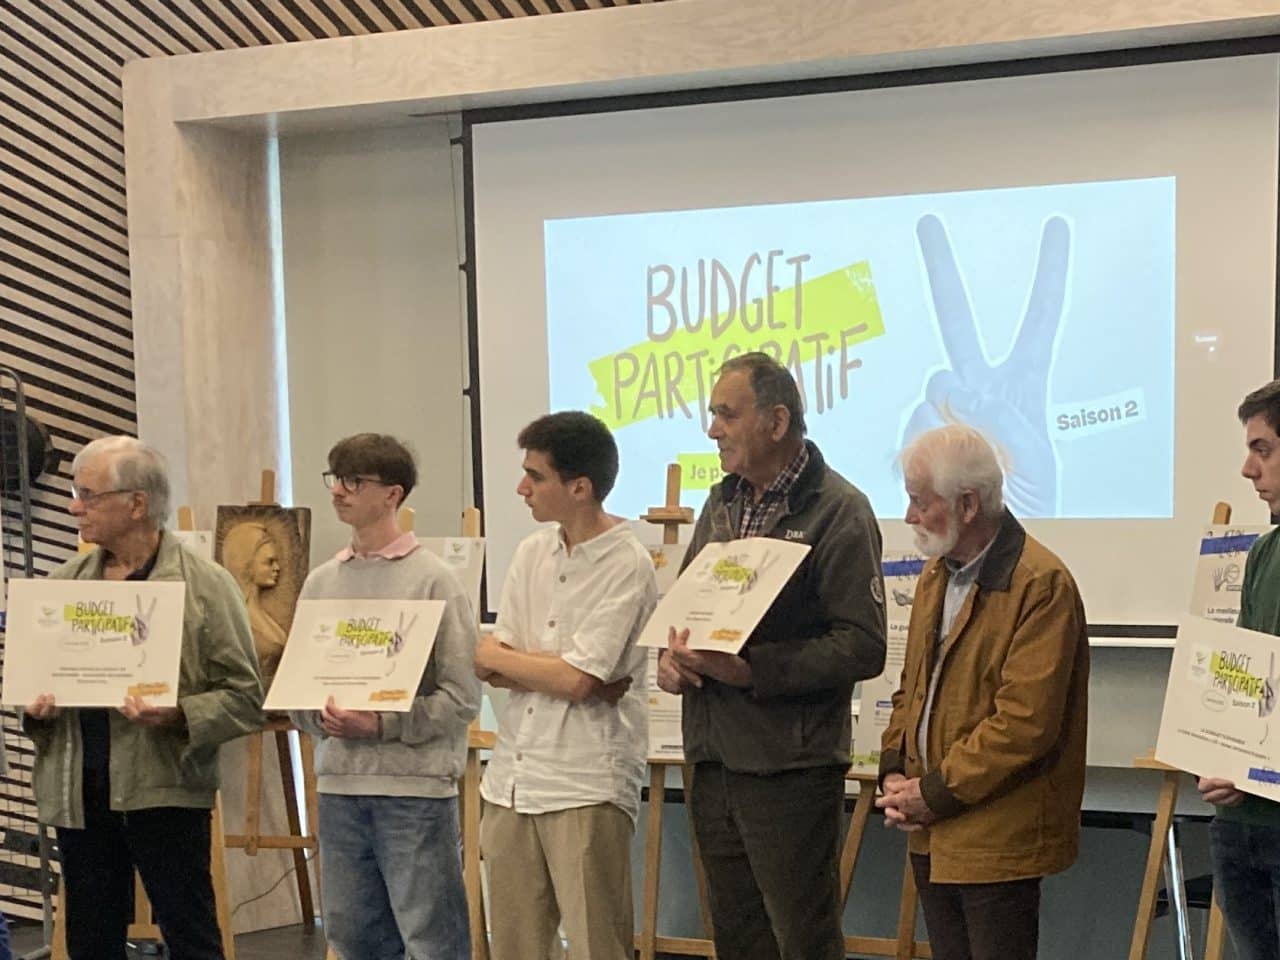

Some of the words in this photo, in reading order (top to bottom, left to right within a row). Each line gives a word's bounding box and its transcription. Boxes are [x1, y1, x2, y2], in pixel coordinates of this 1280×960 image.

[646, 249, 811, 343] BUDGET
[1056, 405, 1122, 431] Saison
[1124, 400, 1139, 418] 2
[690, 463, 706, 480] Je
[709, 466, 723, 482] p
[75, 600, 115, 618] BUDGET
[1219, 650, 1252, 674] BUDGET
